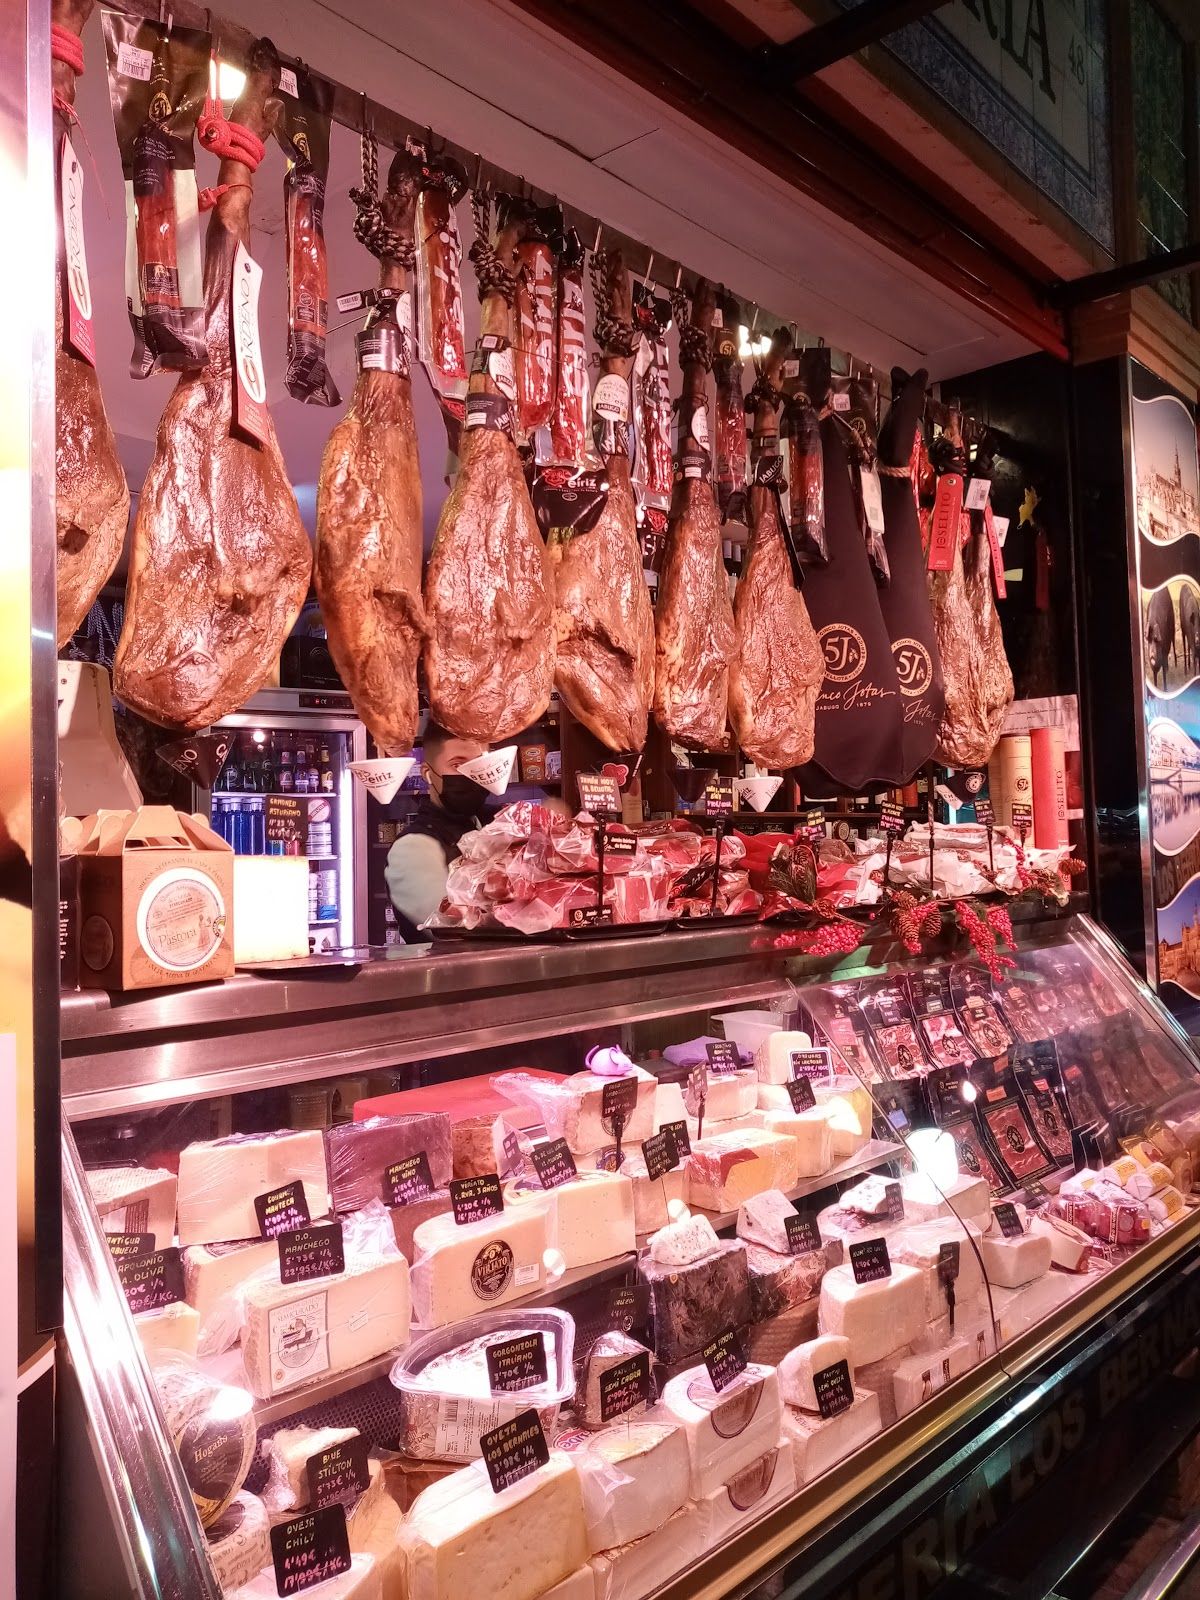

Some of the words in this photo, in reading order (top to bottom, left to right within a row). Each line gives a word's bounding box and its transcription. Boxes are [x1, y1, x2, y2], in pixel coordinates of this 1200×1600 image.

[759, 456, 783, 485] JABUGO
[824, 636, 853, 671] 5J
[896, 650, 924, 684] 5J
[842, 680, 896, 710] Jotas
[470, 760, 509, 781] BEHER
[265, 1197, 295, 1215] MANTECA
[284, 1238, 330, 1255] MANCHEGO
[295, 1232, 312, 1242] D.O.
[286, 1251, 315, 1265] 5'73€
[478, 1255, 508, 1277] VIRIATO
[134, 1265, 164, 1281] OLIVA
[492, 1339, 538, 1359] GORGONZOLA
[318, 1457, 353, 1480] STILTON
[286, 1517, 316, 1535] OVEJA
